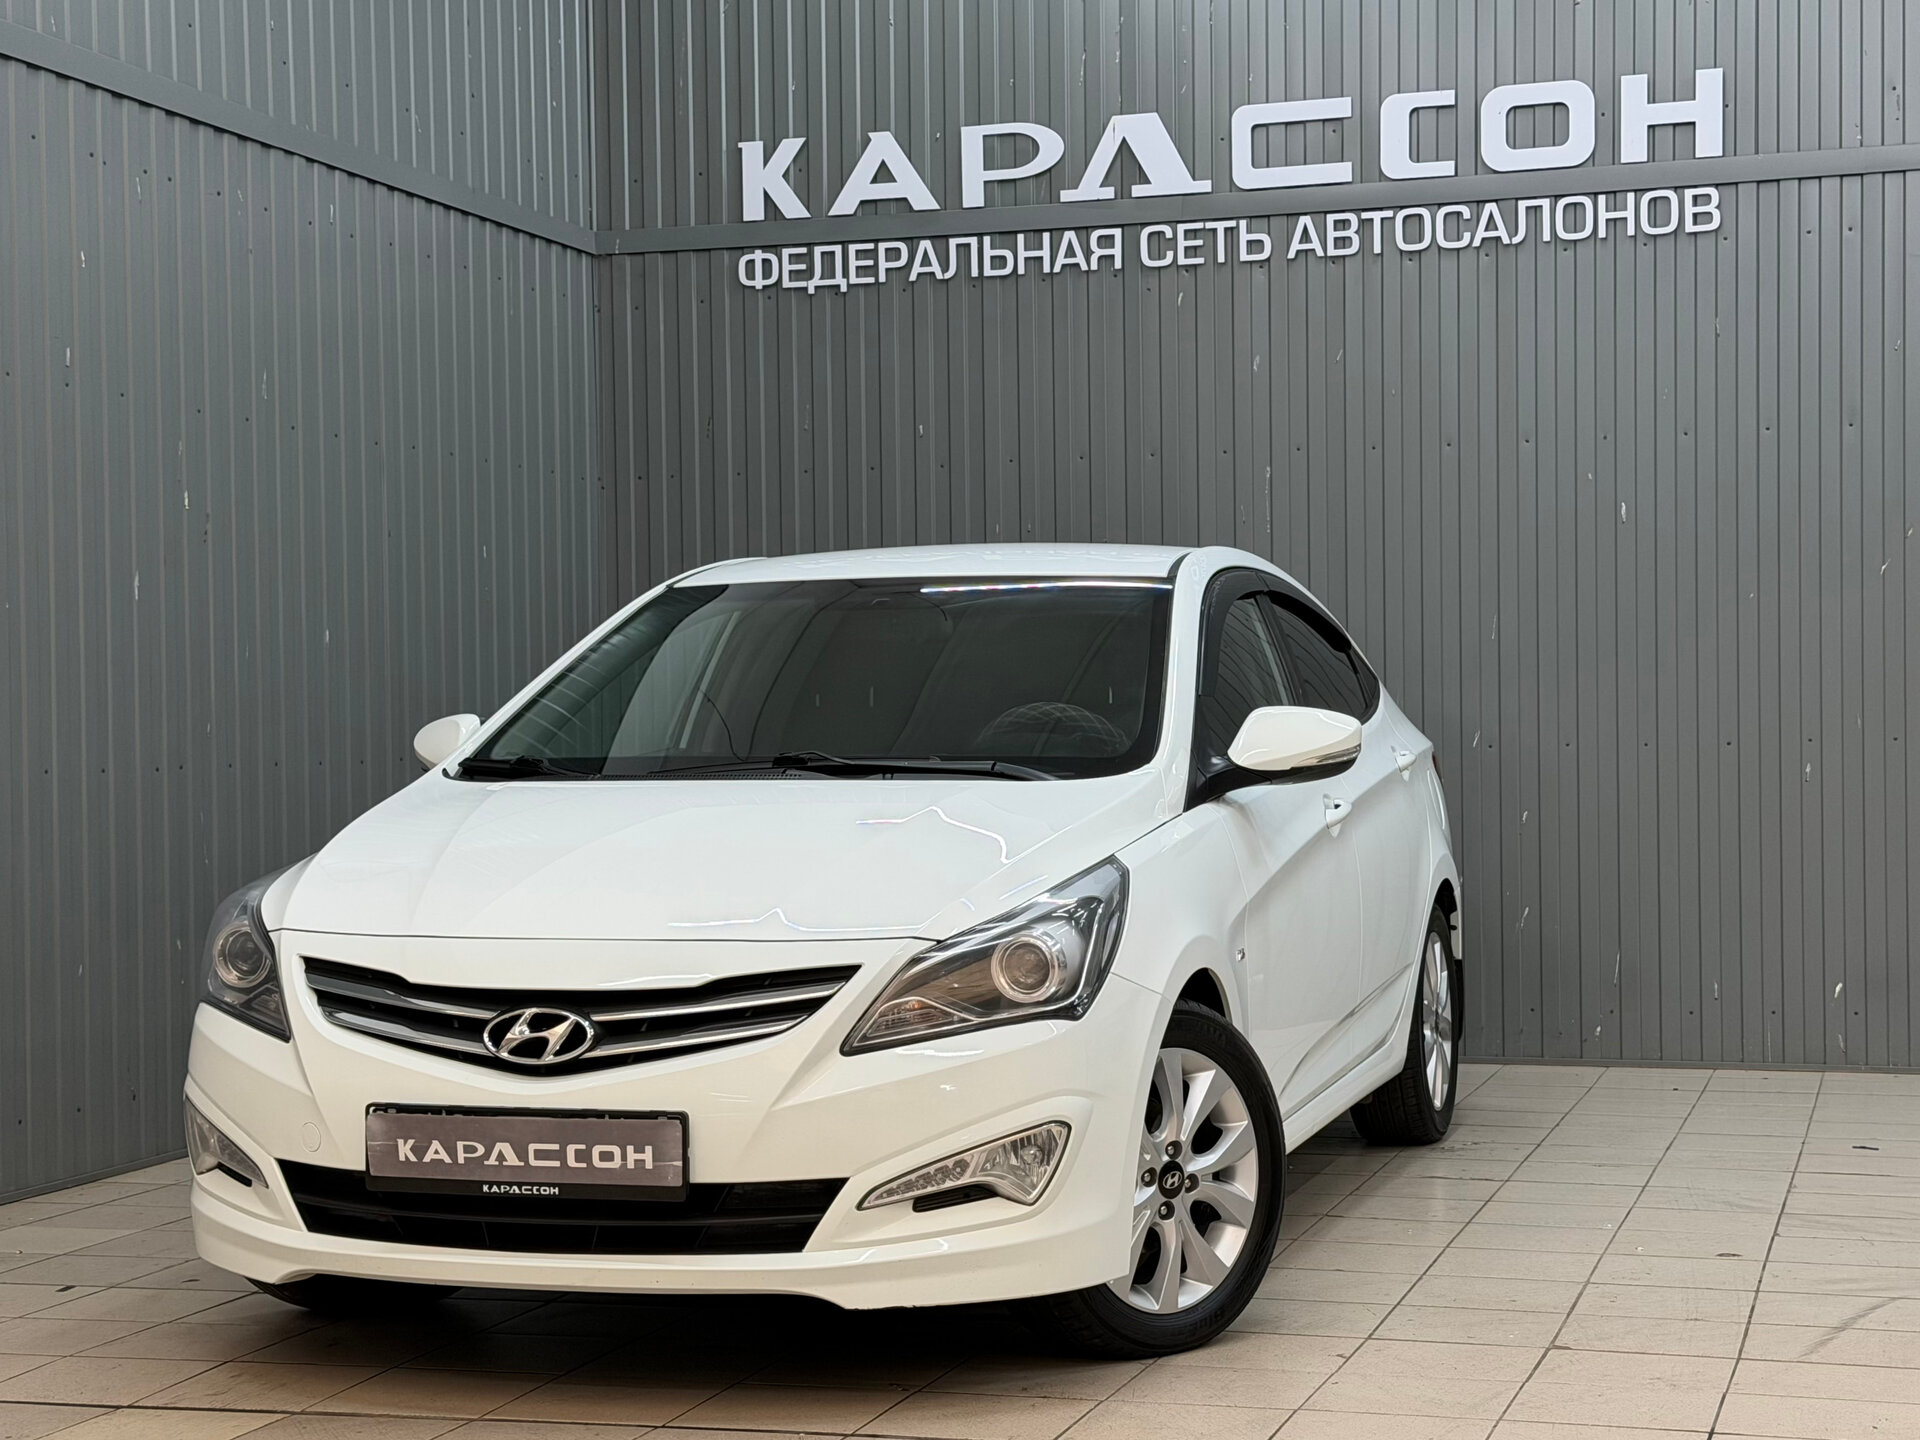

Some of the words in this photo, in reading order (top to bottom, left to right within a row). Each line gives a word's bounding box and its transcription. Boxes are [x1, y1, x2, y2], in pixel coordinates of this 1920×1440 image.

[738, 228, 1124, 296] ФЕДЕРАЛЬНАЯ
[1140, 219, 1273, 268] СЕТЬ
[1287, 187, 1723, 261] АВТОСАЛОНОВ
